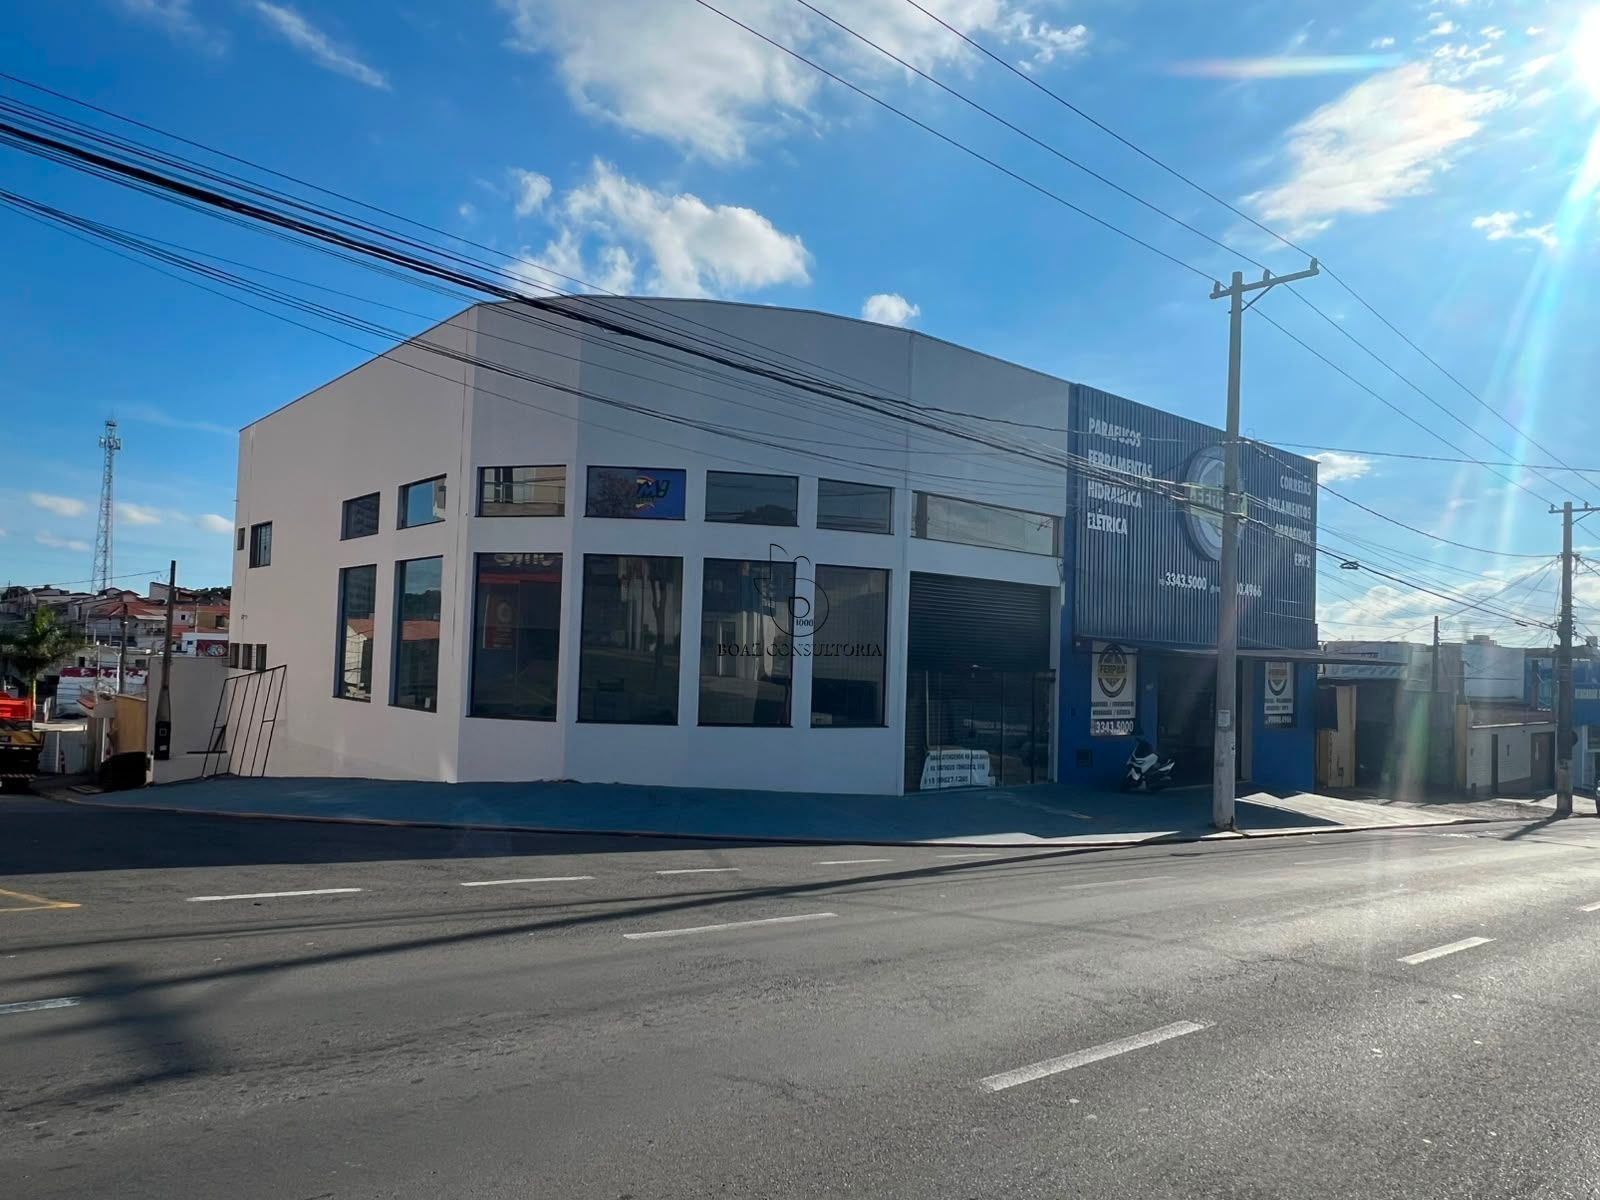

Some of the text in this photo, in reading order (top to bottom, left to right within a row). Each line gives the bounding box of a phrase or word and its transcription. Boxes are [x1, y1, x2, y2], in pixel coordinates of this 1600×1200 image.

[1088, 417, 1141, 447] PARAFUSOS
[1087, 448, 1153, 479] FERRAMENTAS
[1087, 508, 1128, 535] ELÉTRICA
[1165, 572, 1207, 591] 3343.5000
